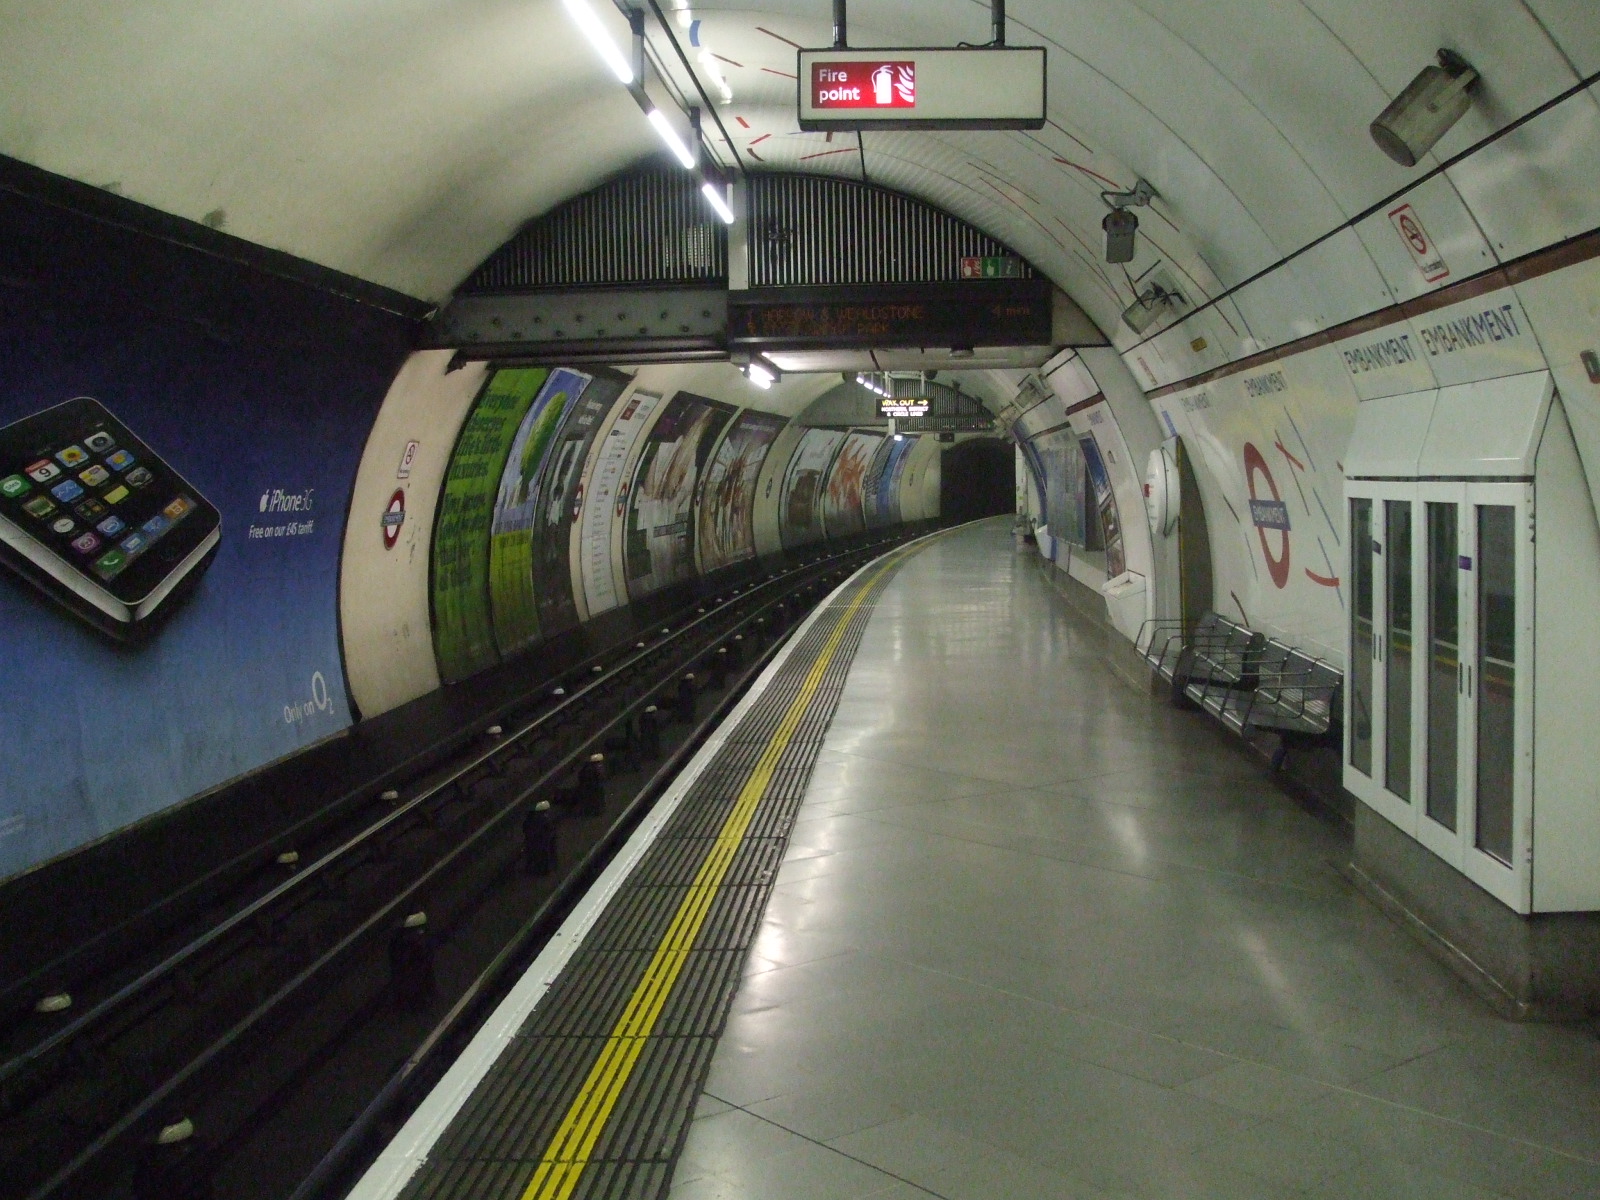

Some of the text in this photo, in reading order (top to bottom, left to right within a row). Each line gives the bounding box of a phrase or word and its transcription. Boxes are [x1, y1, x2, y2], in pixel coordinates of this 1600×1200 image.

[819, 69, 848, 82] Fire
[819, 86, 861, 103] point
[1420, 304, 1520, 356] EMBANKMENT
[1344, 334, 1417, 374] EMBANKMENT
[248, 524, 264, 540] Free
[264, 526, 274, 538] on
[275, 526, 286, 537] our
[283, 701, 303, 724] Only
[303, 701, 315, 716] on
